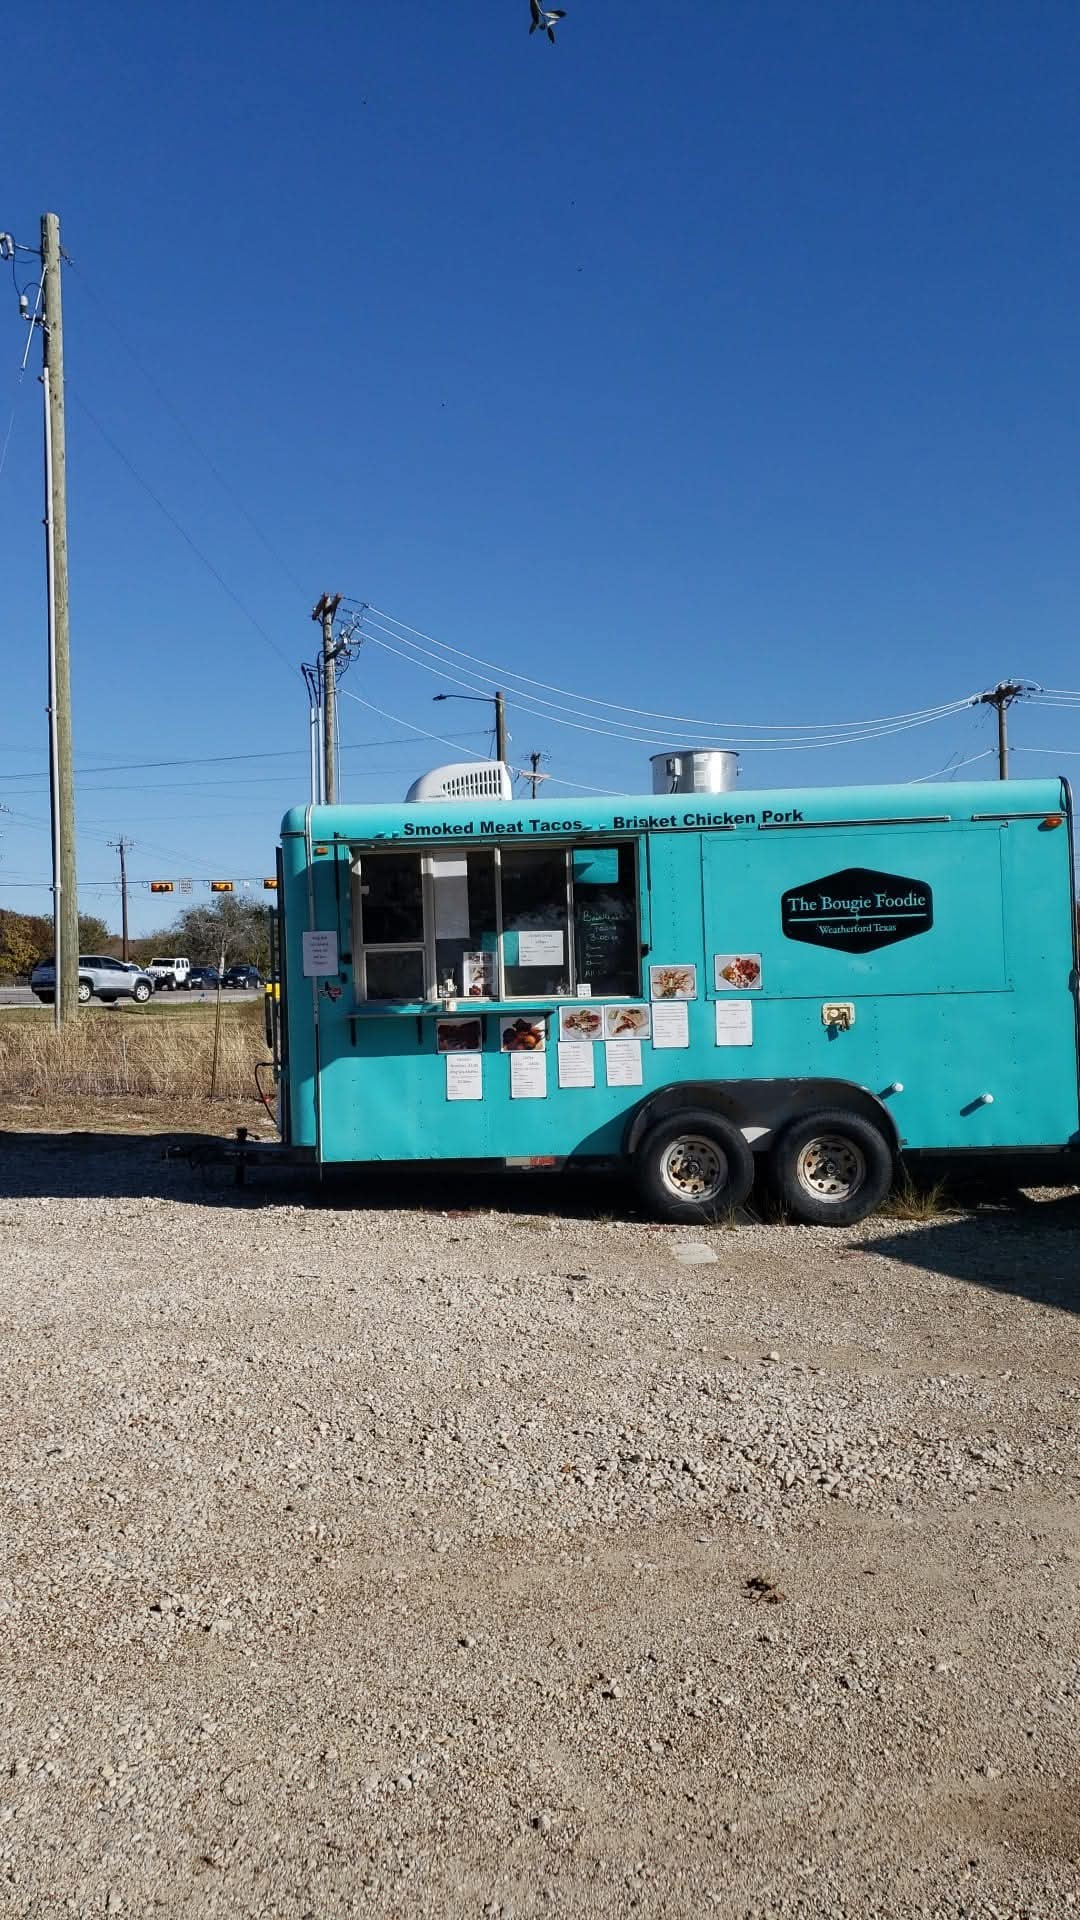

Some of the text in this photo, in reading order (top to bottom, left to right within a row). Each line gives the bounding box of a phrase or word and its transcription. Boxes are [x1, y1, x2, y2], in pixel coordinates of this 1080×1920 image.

[403, 808, 804, 836] Smoked Meat Tacos Brisket Chicken Pork
[787, 892, 926, 913] The Bougie Foodie
[819, 923, 897, 934] Weatherford Texas
